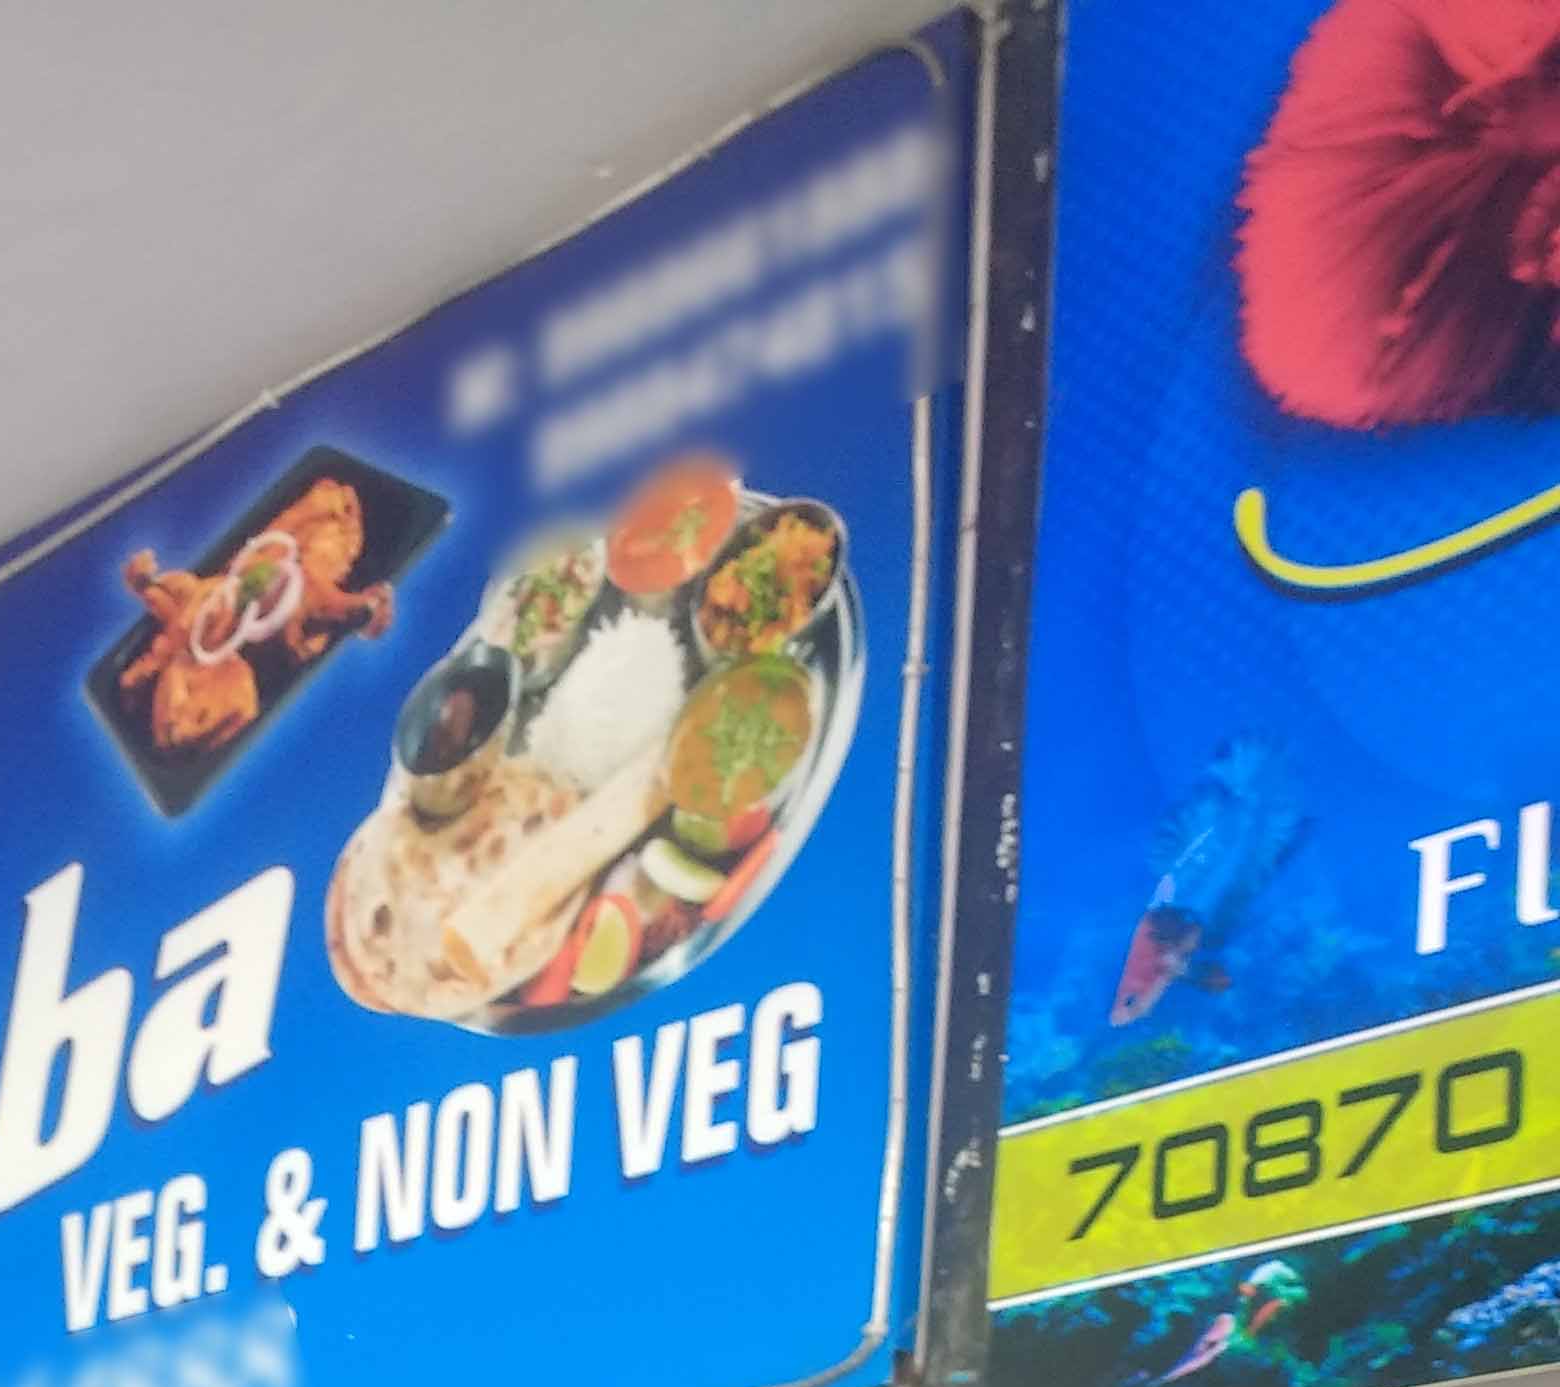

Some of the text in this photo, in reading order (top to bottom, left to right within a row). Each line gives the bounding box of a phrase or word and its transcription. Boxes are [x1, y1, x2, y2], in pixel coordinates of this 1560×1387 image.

[60, 981, 827, 1334] VEG. & NON VEG
[1067, 1049, 1524, 1241] 70870
